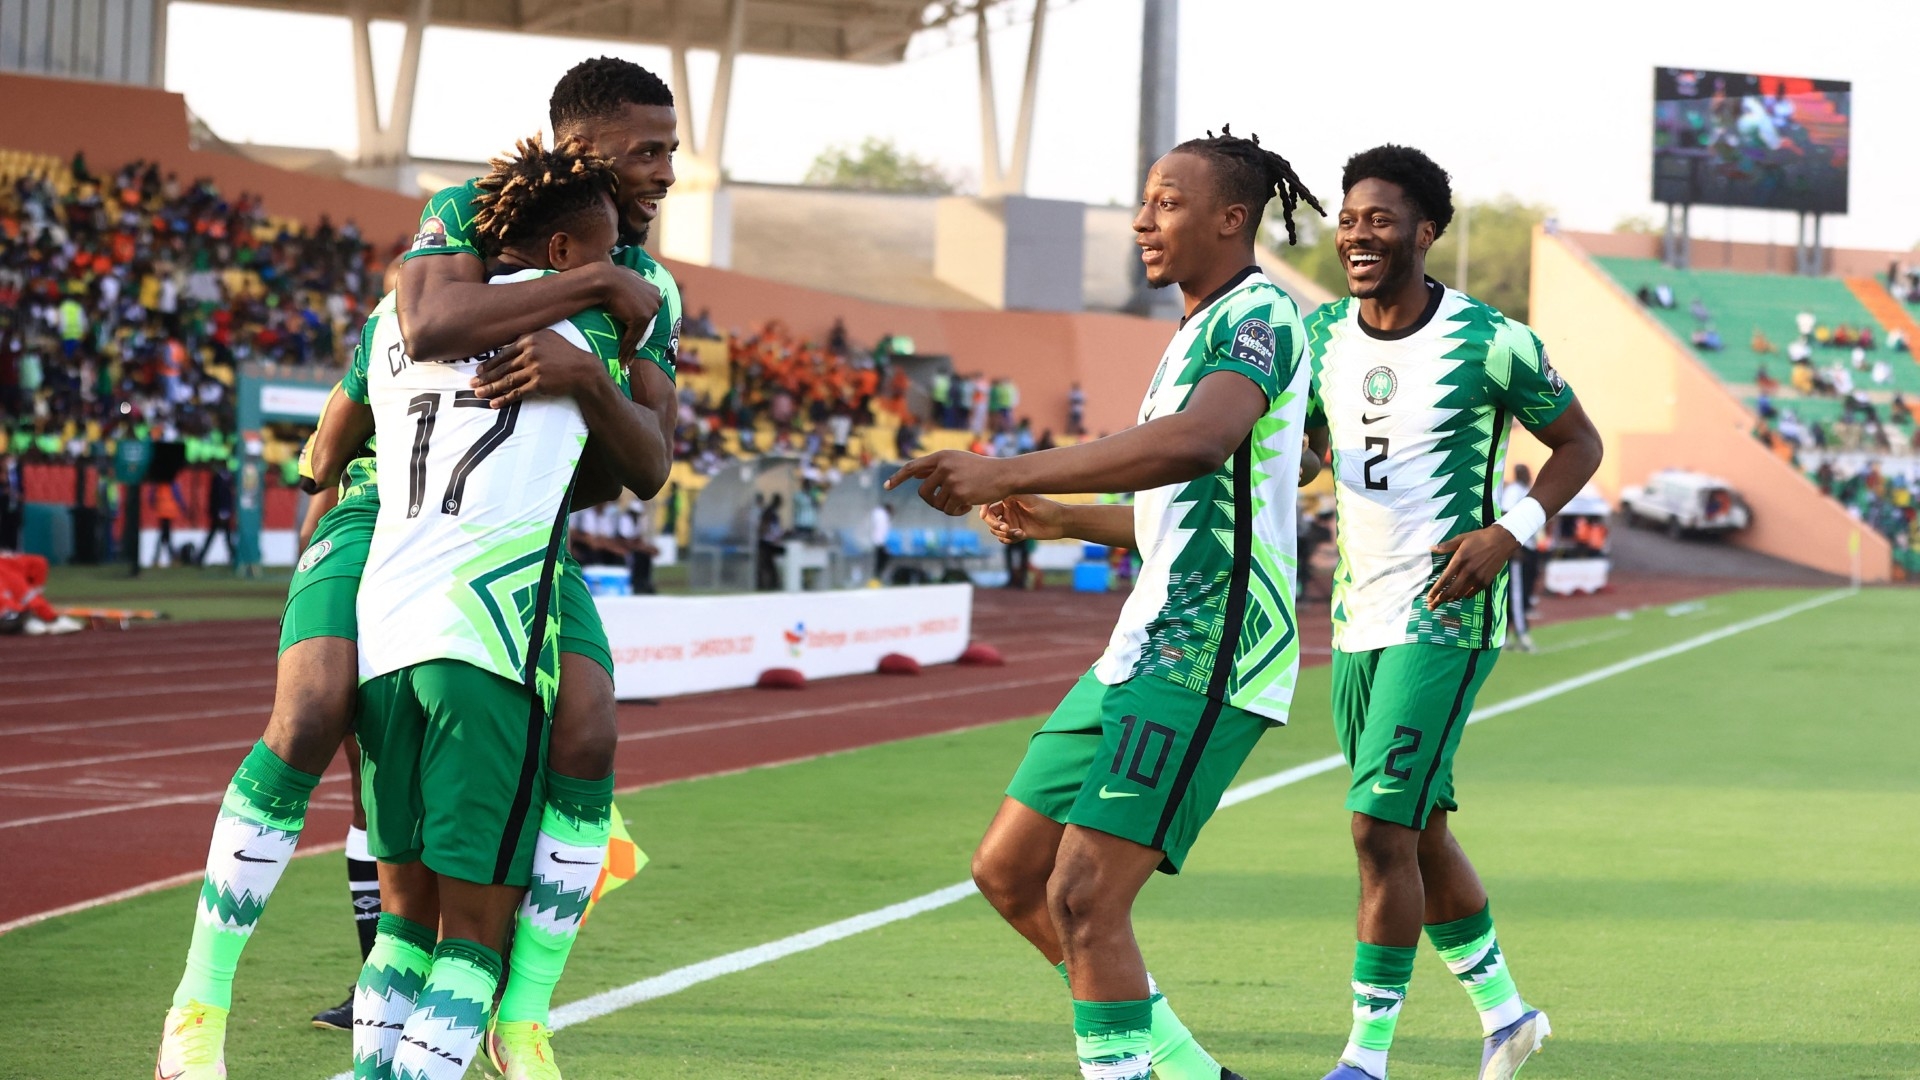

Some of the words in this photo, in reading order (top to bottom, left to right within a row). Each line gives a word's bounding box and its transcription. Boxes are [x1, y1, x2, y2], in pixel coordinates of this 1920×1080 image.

[406, 389, 522, 519] 17
[1364, 436, 1389, 491] 2
[1110, 715, 1177, 790] 10
[1384, 724, 1423, 781] 2
[353, 1018, 405, 1030] AIJA
[400, 1034, 463, 1067] NAIJA
